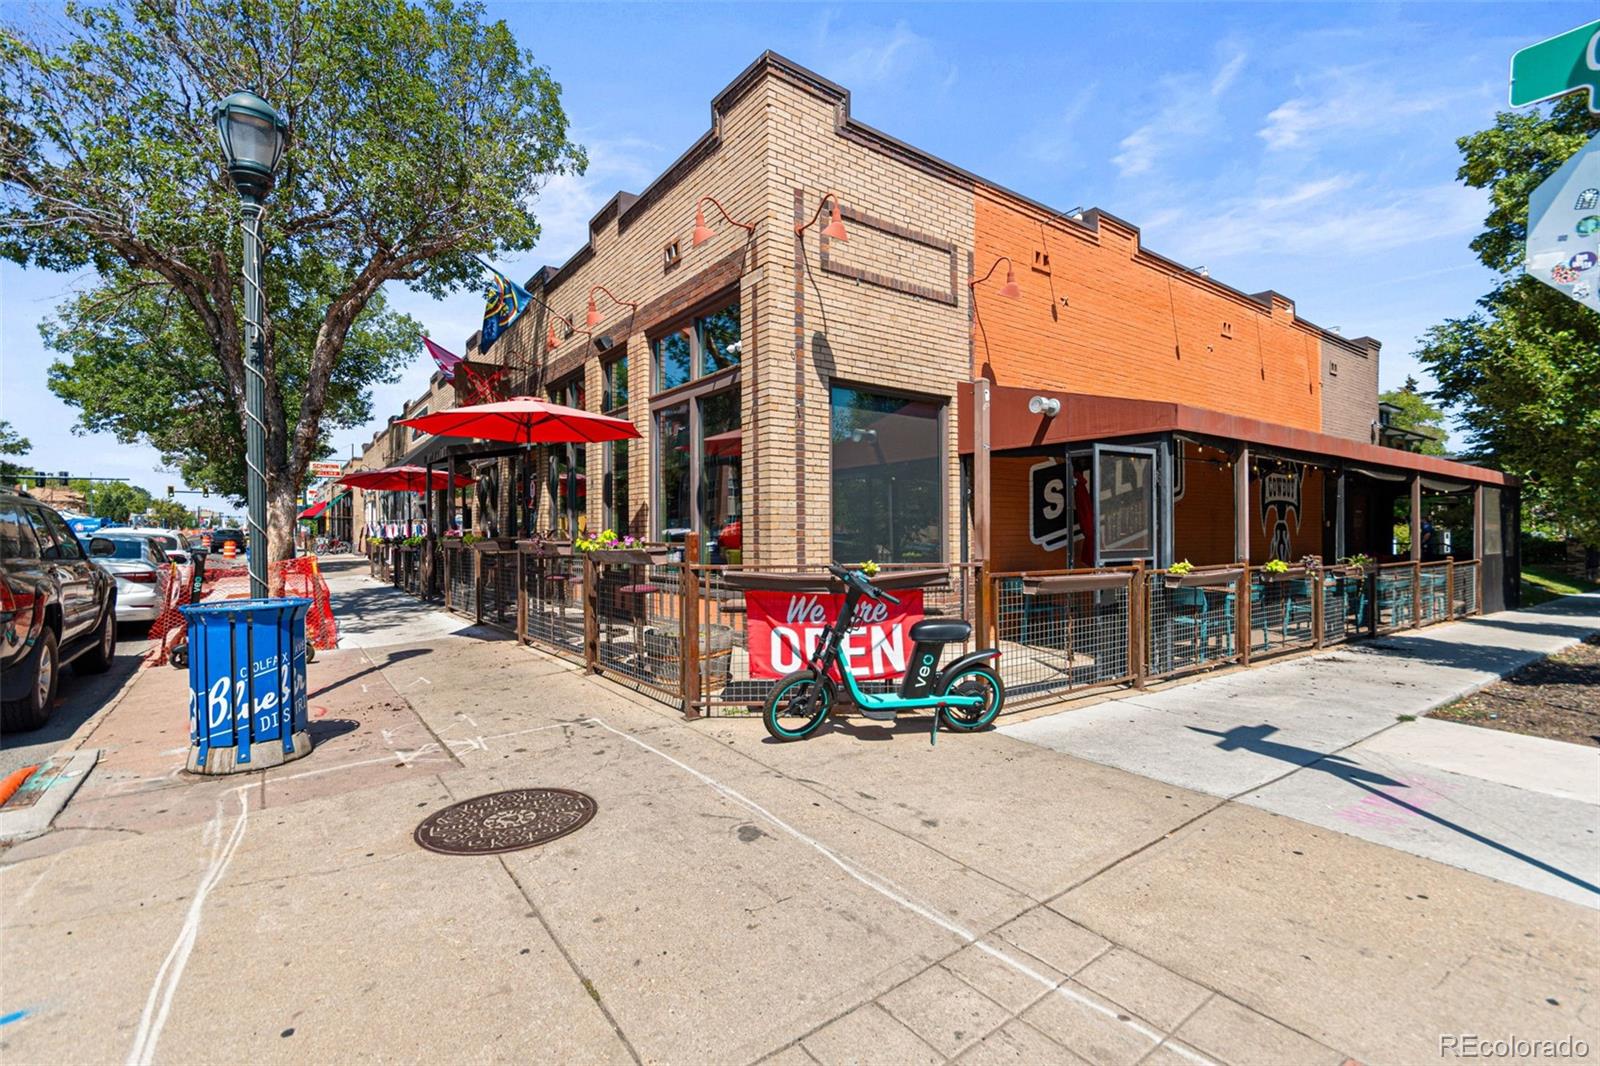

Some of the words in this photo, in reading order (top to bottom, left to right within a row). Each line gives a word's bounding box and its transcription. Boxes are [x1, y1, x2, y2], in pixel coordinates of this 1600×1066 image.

[786, 595, 826, 624] We
[853, 600, 888, 623] re
[240, 651, 288, 678] COLFAX
[914, 654, 934, 688] veo
